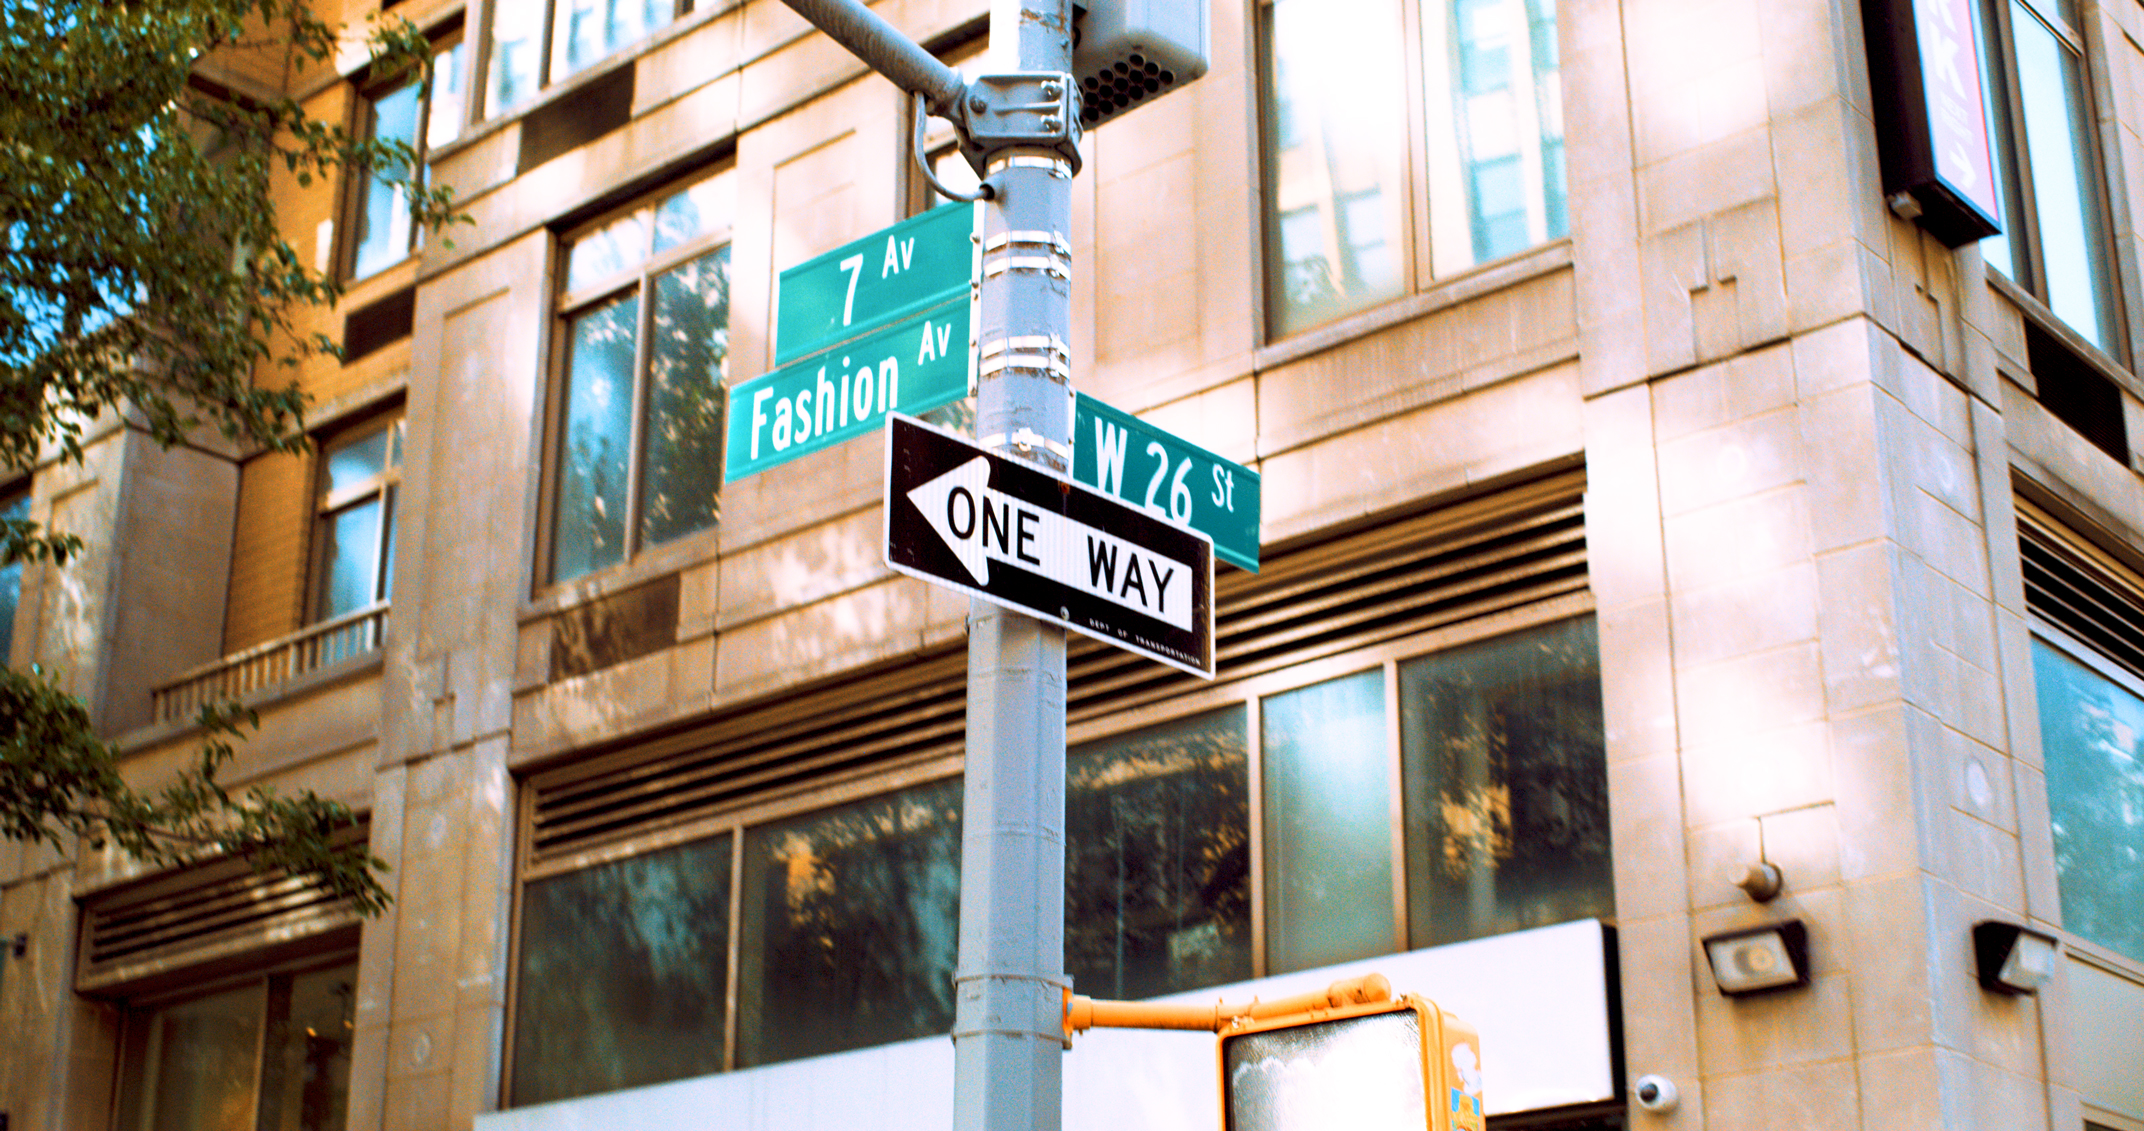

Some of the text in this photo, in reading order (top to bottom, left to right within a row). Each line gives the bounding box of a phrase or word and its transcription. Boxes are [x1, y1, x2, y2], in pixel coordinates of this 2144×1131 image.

[840, 235, 914, 327] 7 Av
[750, 321, 951, 460] Fashion Av
[1095, 416, 1234, 525] W 26 St
[947, 486, 1174, 613] ONE WAY
[1089, 618, 1201, 666] DEPT OF TRANSPORTATION
